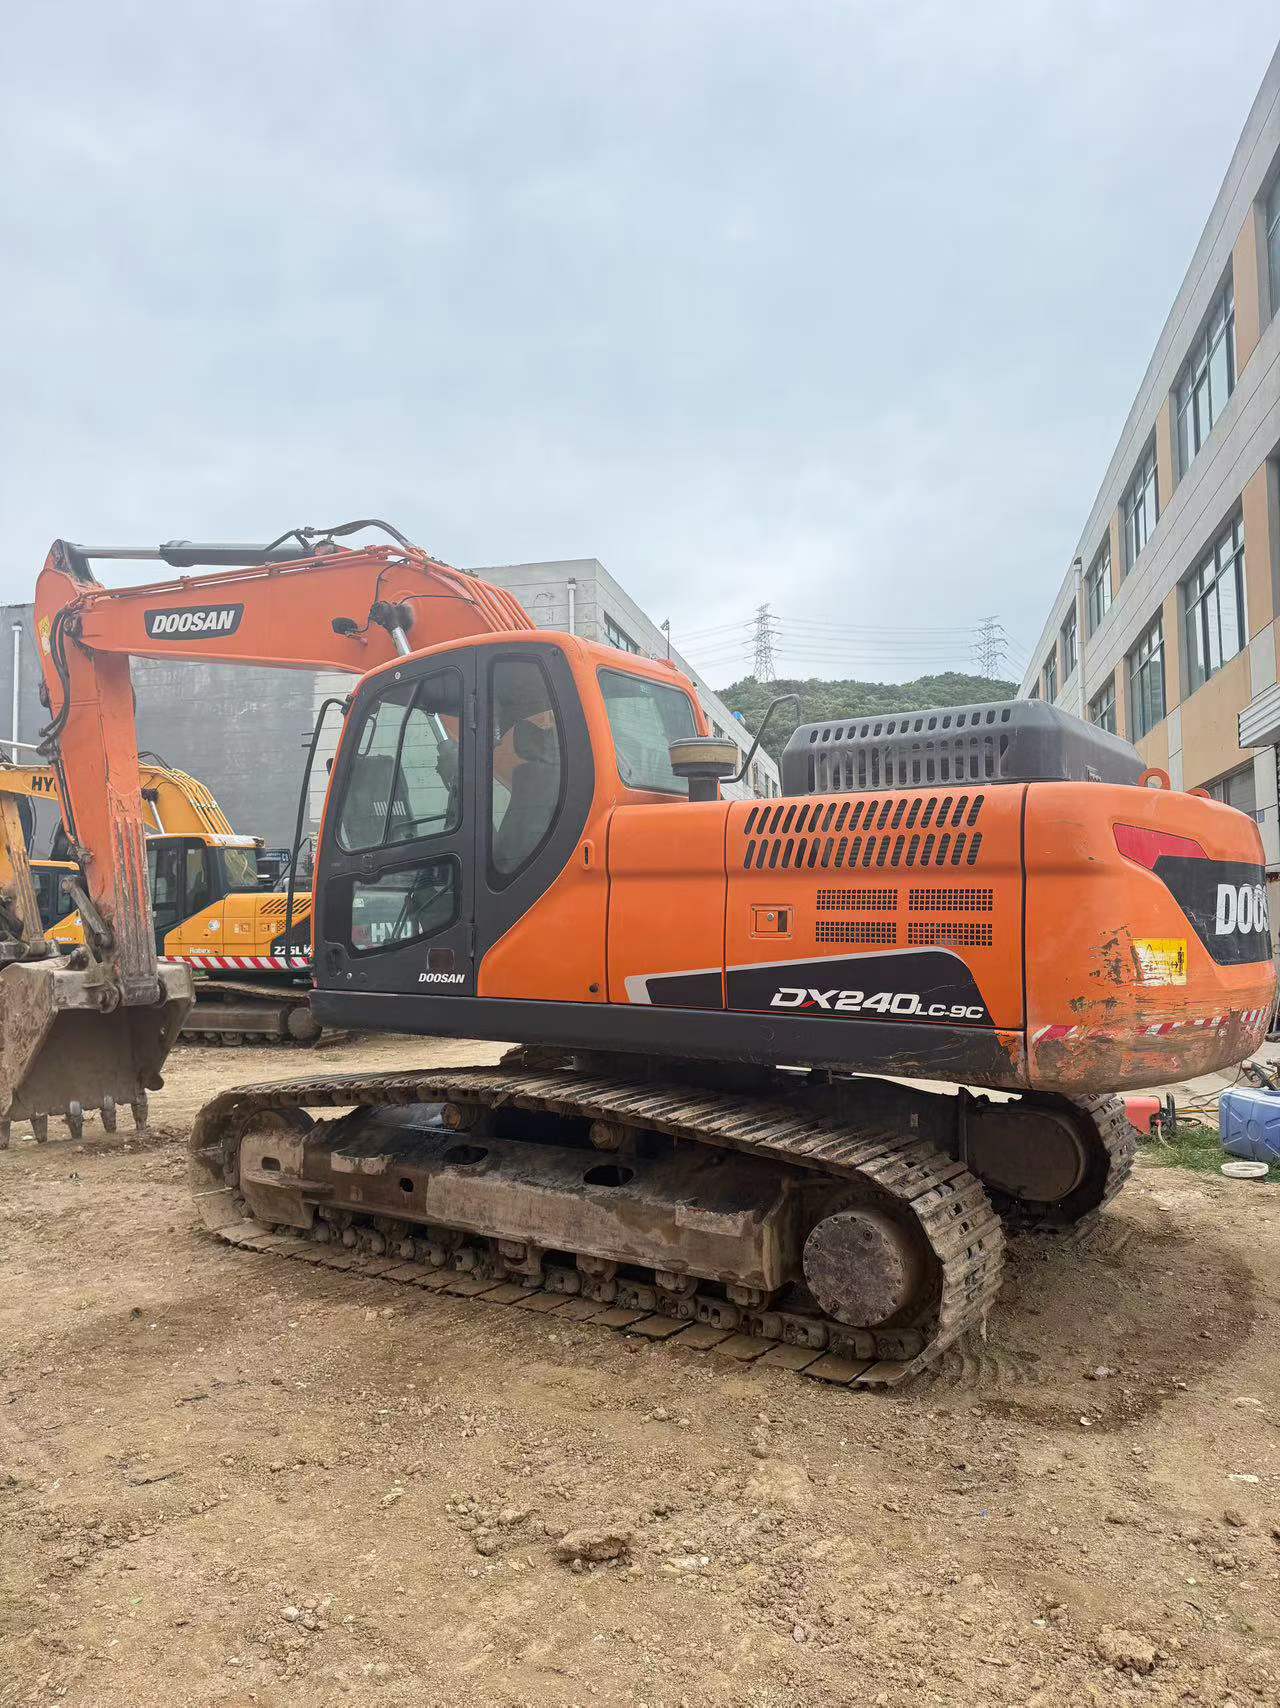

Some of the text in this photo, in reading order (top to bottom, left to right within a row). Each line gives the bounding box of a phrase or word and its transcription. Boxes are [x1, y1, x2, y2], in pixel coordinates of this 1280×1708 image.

[151, 610, 236, 634] DOOSAN
[31, 775, 57, 792] HY
[418, 972, 466, 984] DOOSAN
